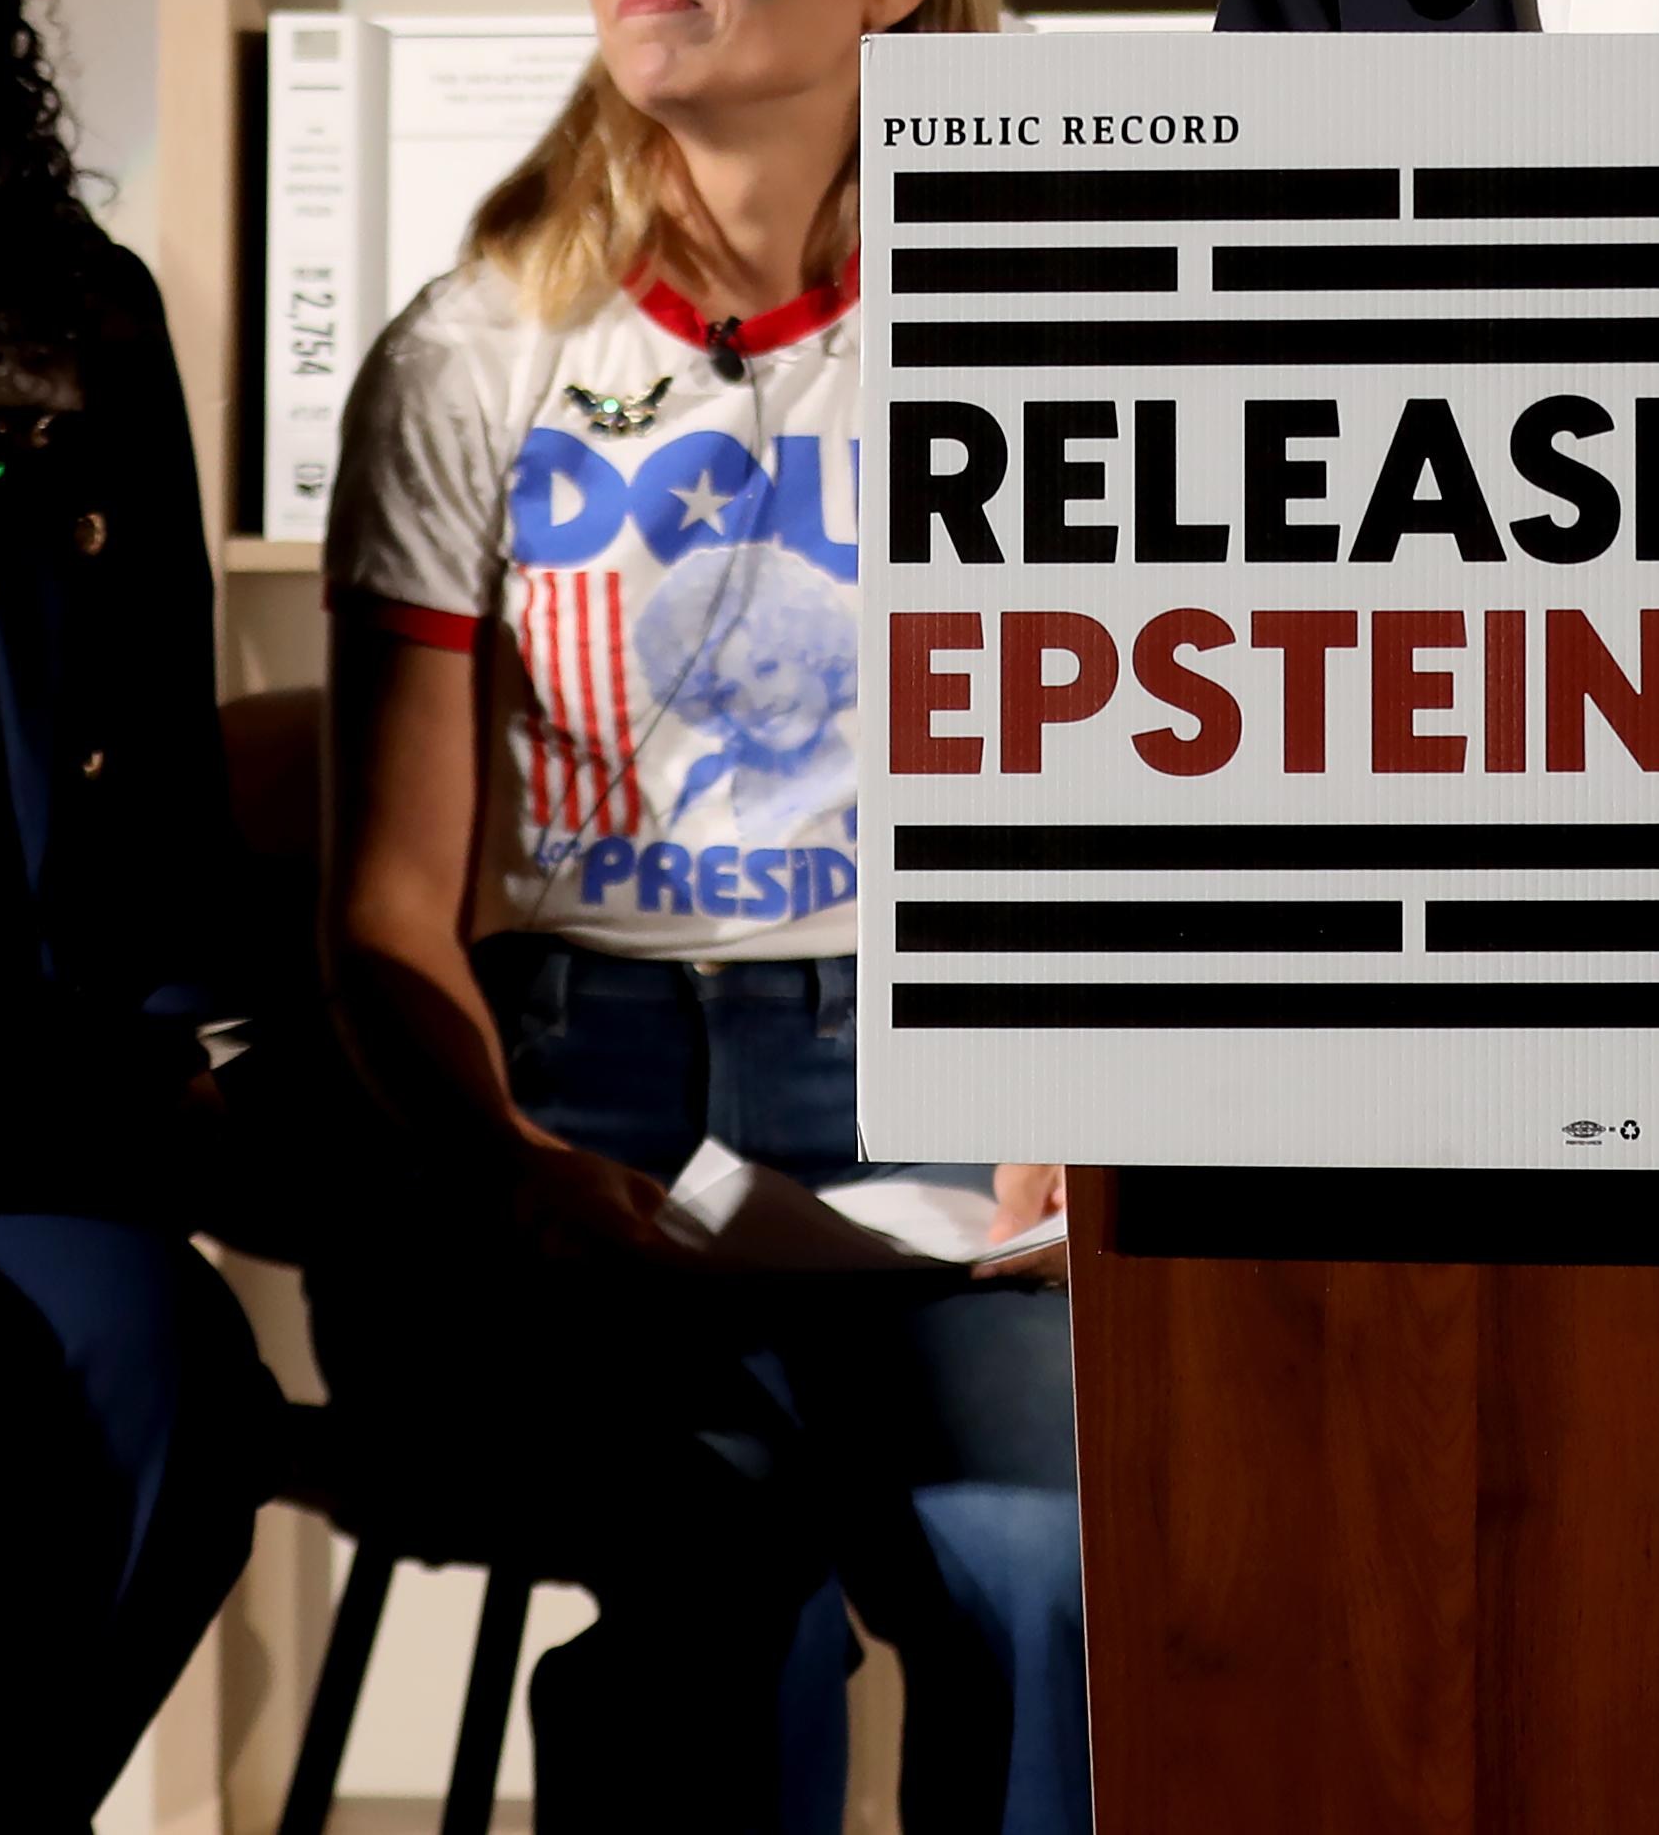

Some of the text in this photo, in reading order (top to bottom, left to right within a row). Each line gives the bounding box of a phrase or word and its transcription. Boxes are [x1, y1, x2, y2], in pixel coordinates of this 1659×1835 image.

[884, 115, 1239, 146] PUBLIC RECORD
[288, 291, 335, 375] 2,754
[581, 836, 857, 922] PRESID
